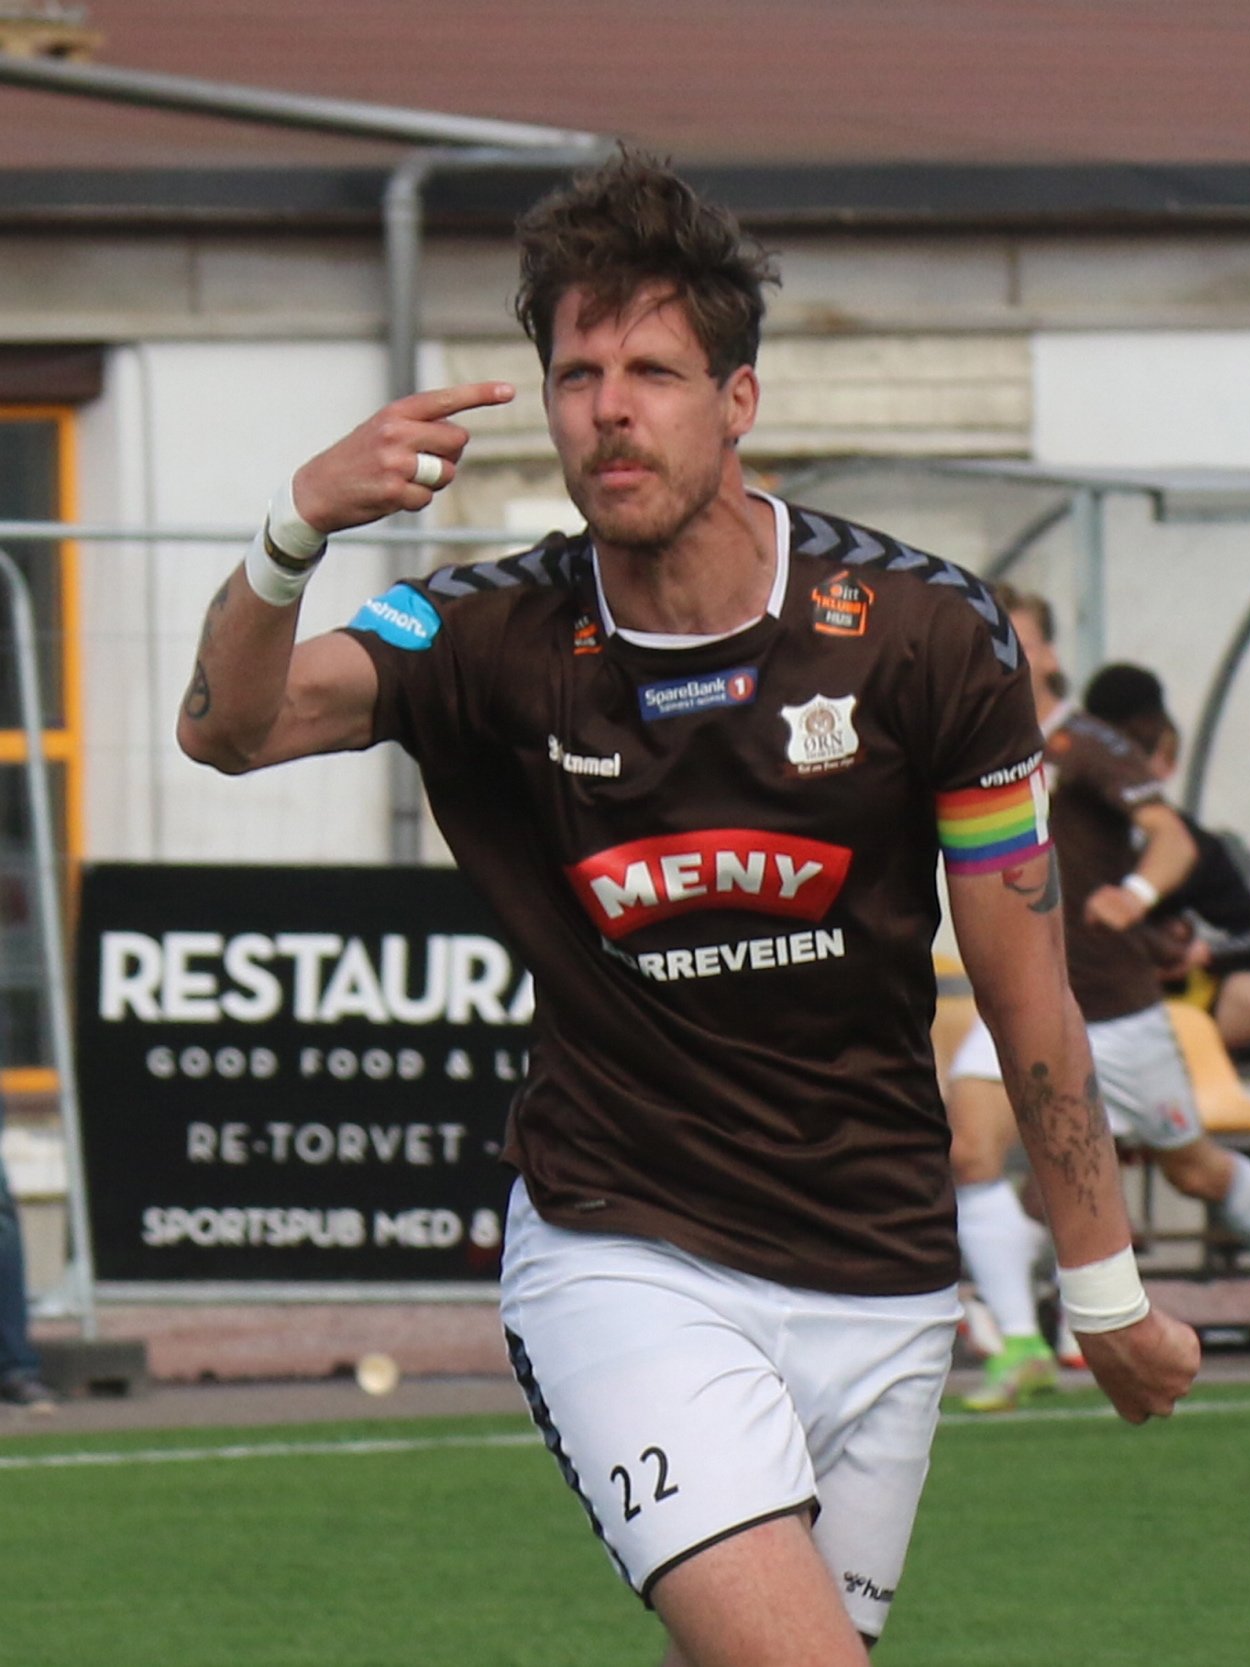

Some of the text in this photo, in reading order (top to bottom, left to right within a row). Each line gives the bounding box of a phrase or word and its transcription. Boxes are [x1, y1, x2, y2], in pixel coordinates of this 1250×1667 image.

[645, 677, 726, 707] SpareBank
[734, 677, 746, 696] 1
[590, 850, 824, 920] MENY
[603, 928, 846, 983] RREVEIEN
[145, 1046, 279, 1080] GOOD
[300, 1047, 426, 1080] FOOD
[186, 1120, 467, 1166] RE-TORVET
[141, 1206, 365, 1248] SPORTSPUB
[373, 1209, 463, 1248] MED
[609, 1445, 679, 1523] 22
